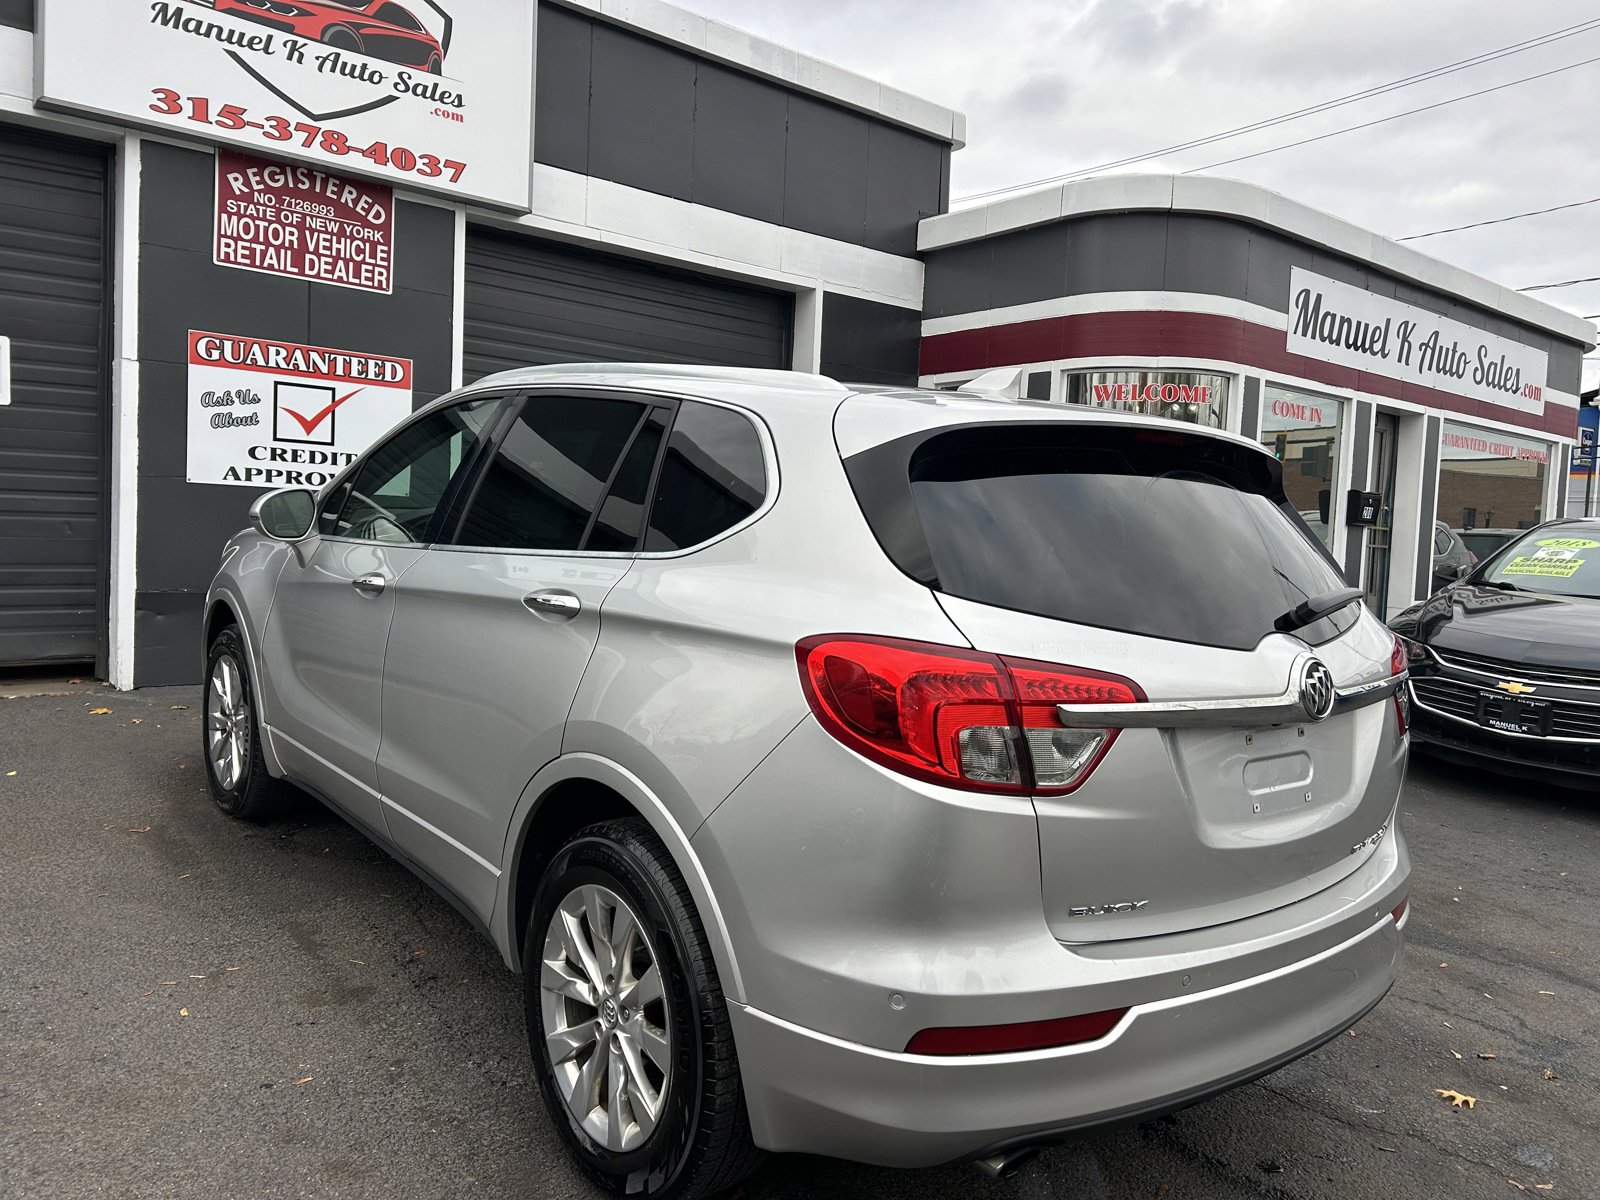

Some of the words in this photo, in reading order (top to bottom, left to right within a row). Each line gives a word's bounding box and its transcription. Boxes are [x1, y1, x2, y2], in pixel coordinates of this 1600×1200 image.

[150, 1, 276, 55] Manuel
[282, 39, 309, 65] K
[314, 51, 389, 85] Auto
[392, 71, 466, 108] Sales
[429, 106, 464, 123] .com
[149, 87, 467, 184] 315-378-4037
[226, 166, 386, 225] REGISTERED
[253, 191, 280, 208] NO.
[281, 195, 335, 217] 7126993
[226, 199, 276, 220] STATE
[280, 210, 302, 225] OF
[305, 215, 340, 233] NEW
[343, 223, 384, 243] YORK
[220, 212, 299, 249] MOTOR
[304, 230, 389, 267] VEHICLE
[219, 237, 299, 273] RETAIL
[304, 253, 388, 289] DEALER
[1293, 288, 1391, 359] Manuel
[1396, 320, 1416, 366] K
[1418, 330, 1471, 380] Auto
[195, 335, 405, 383] GUARANTEED
[200, 389, 235, 408] Ask
[235, 388, 261, 405] Us
[1092, 383, 1212, 405] WELCOME
[210, 411, 260, 429] About
[1272, 399, 1307, 421] COME
[1309, 406, 1322, 424] IN
[247, 445, 358, 467] CREDIT
[1489, 442, 1514, 458] CREDIT
[1544, 539, 1593, 547] 2018
[1489, 719, 1519, 729] MANUEL
[1068, 899, 1149, 917] BUICK
